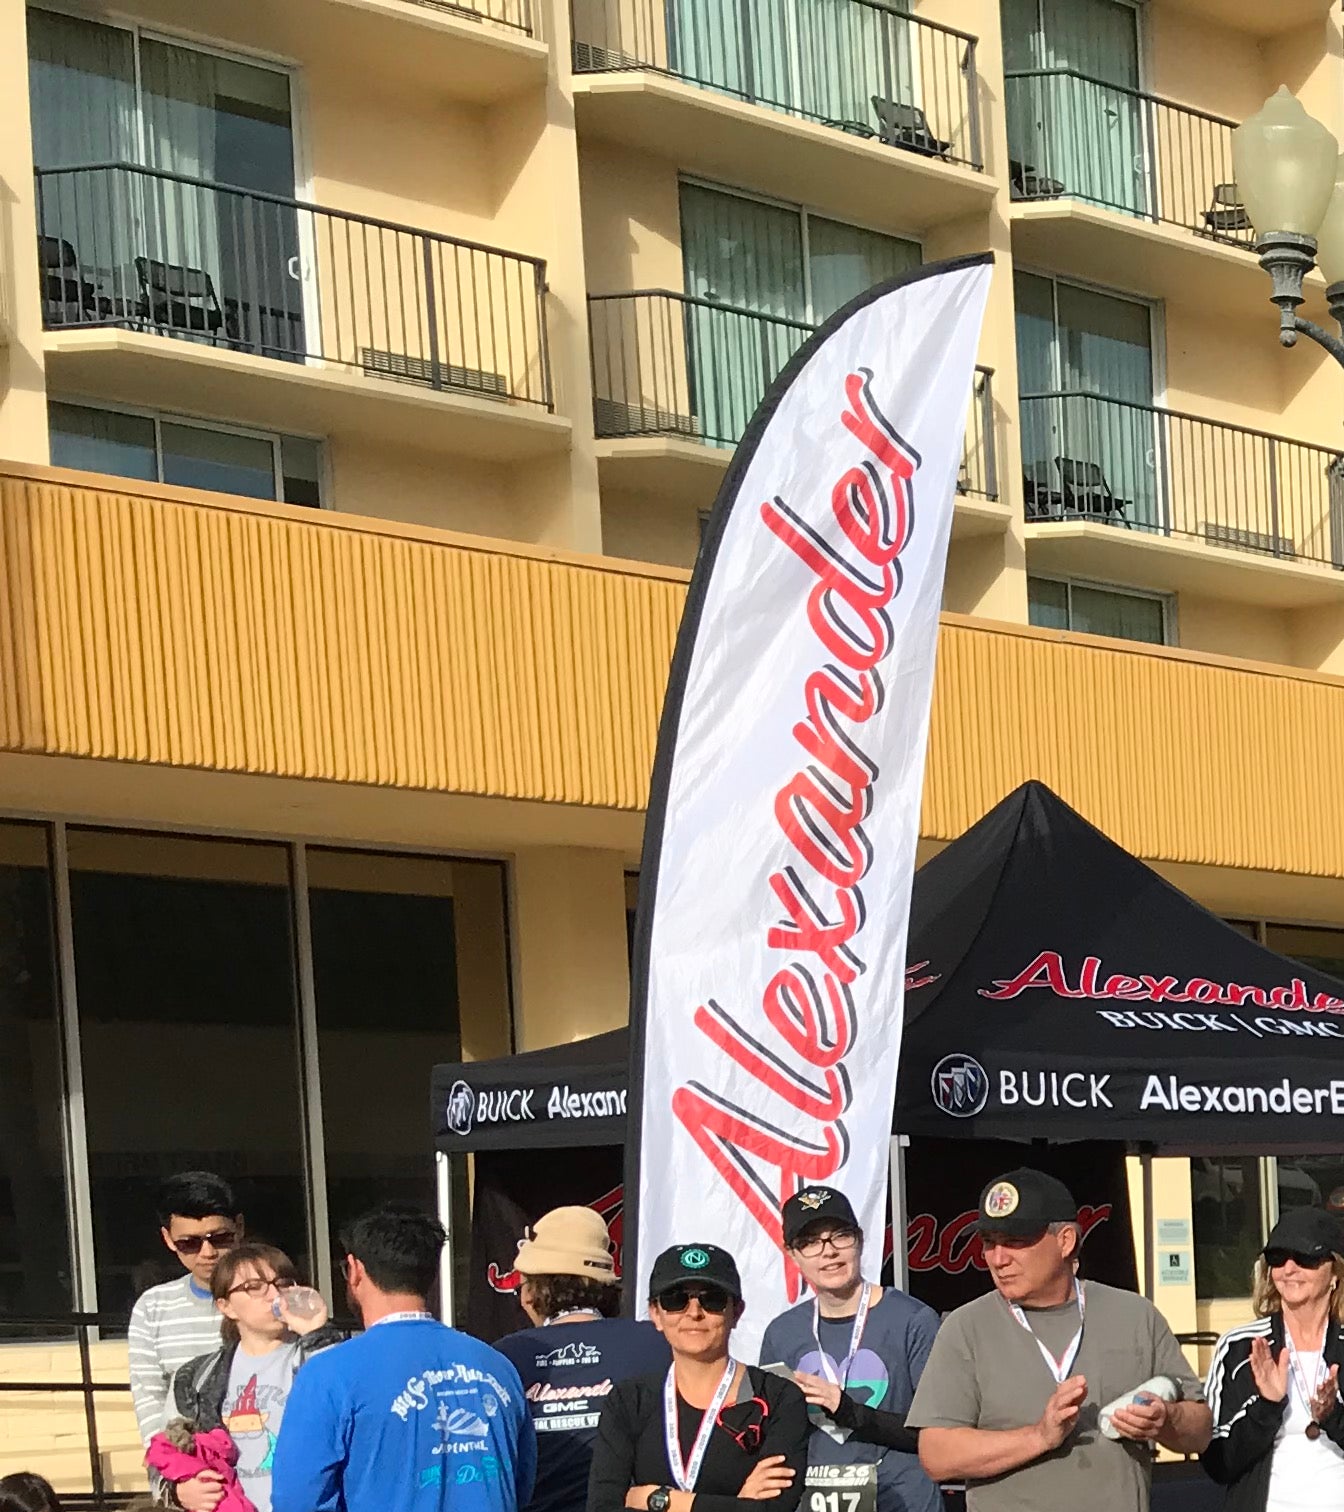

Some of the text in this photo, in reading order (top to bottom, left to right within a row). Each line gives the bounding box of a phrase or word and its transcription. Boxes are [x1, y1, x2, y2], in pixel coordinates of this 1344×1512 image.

[671, 366, 923, 1306] Alexander
[1096, 1010, 1238, 1032] BUICK
[1000, 1070, 1114, 1109] BUICK
[476, 1088, 536, 1123] BUICK
[543, 1399, 589, 1413] GMC
[806, 1465, 870, 1478] Mile 26
